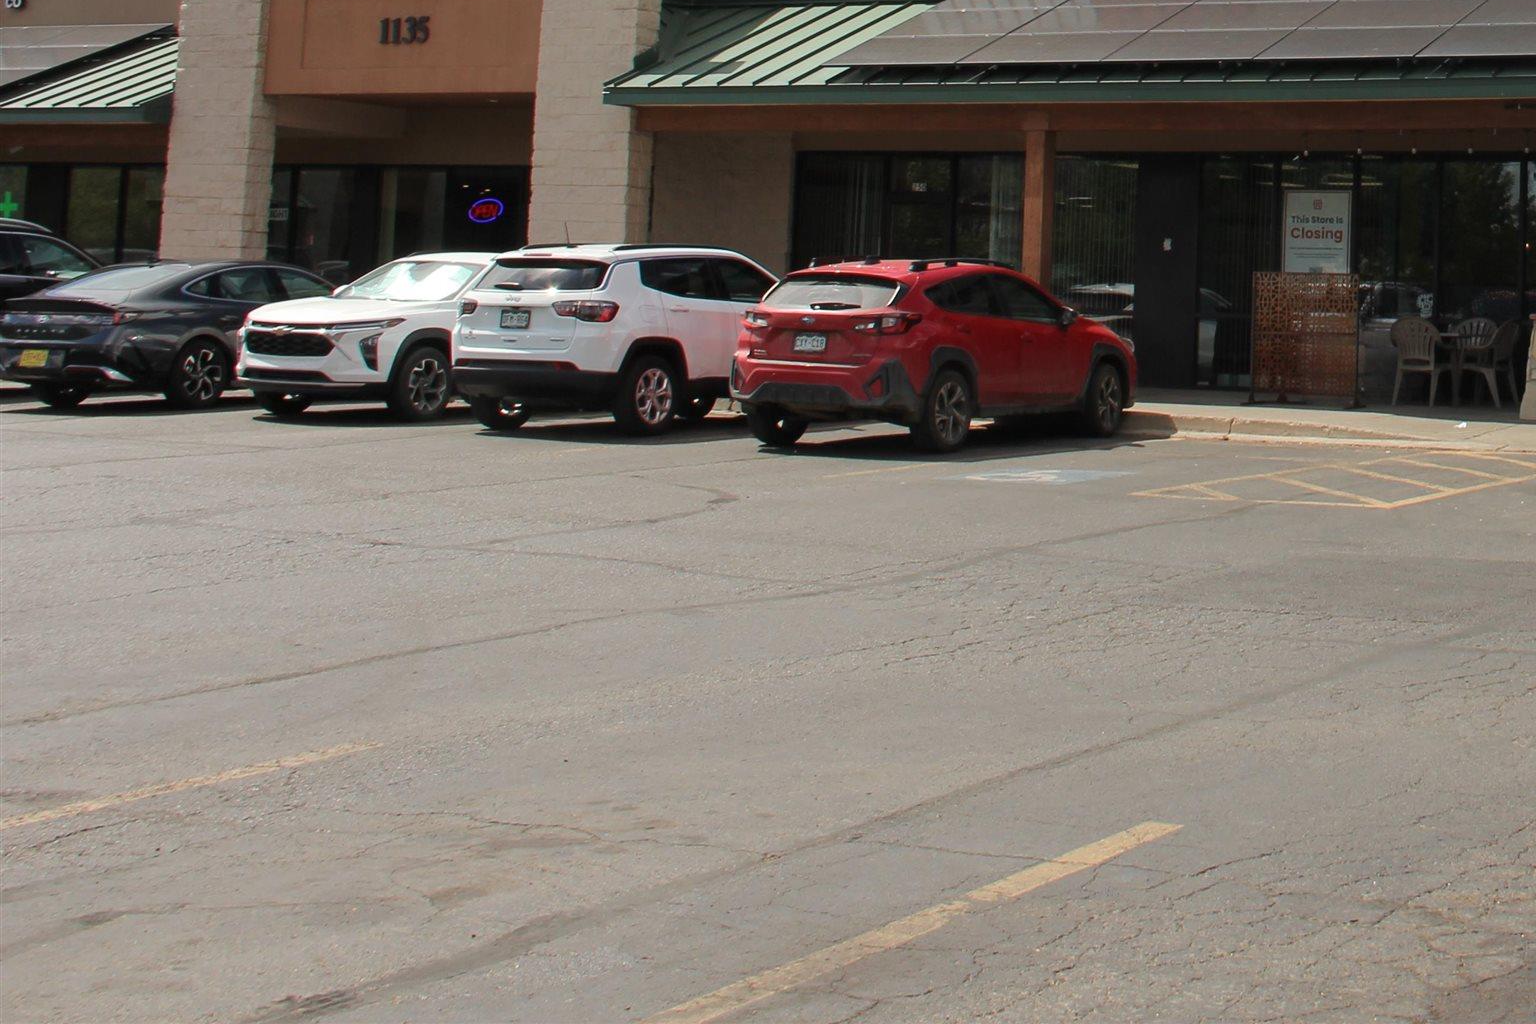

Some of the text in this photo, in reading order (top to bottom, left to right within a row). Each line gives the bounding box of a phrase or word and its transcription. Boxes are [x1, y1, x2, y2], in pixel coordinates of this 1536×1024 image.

[379, 15, 430, 45] 1135
[1291, 215, 1310, 224] This
[1311, 215, 1336, 224] Store
[1290, 227, 1344, 244] Closing
